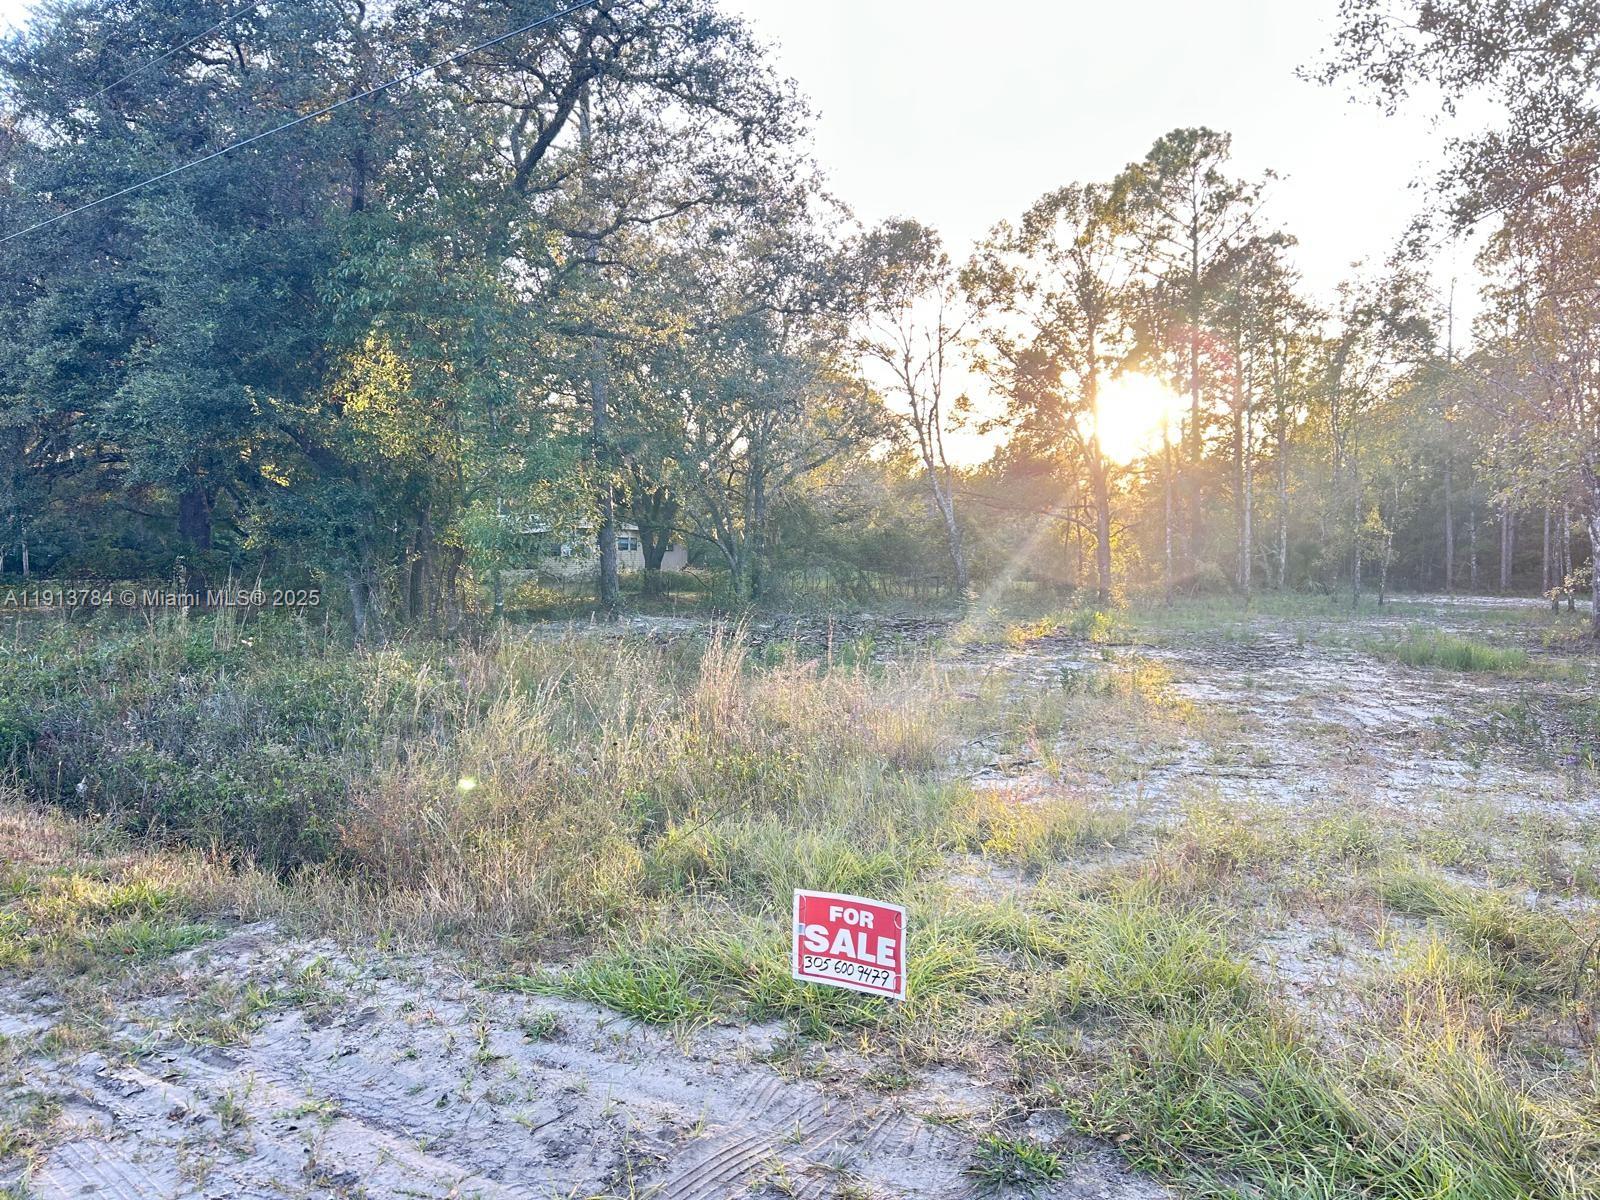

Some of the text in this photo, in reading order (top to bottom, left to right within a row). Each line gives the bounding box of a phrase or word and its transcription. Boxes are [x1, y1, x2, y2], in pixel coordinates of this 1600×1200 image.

[829, 905, 875, 929] FOR
[803, 924, 896, 968] SALE
[804, 956, 890, 986] 305 600 9479
